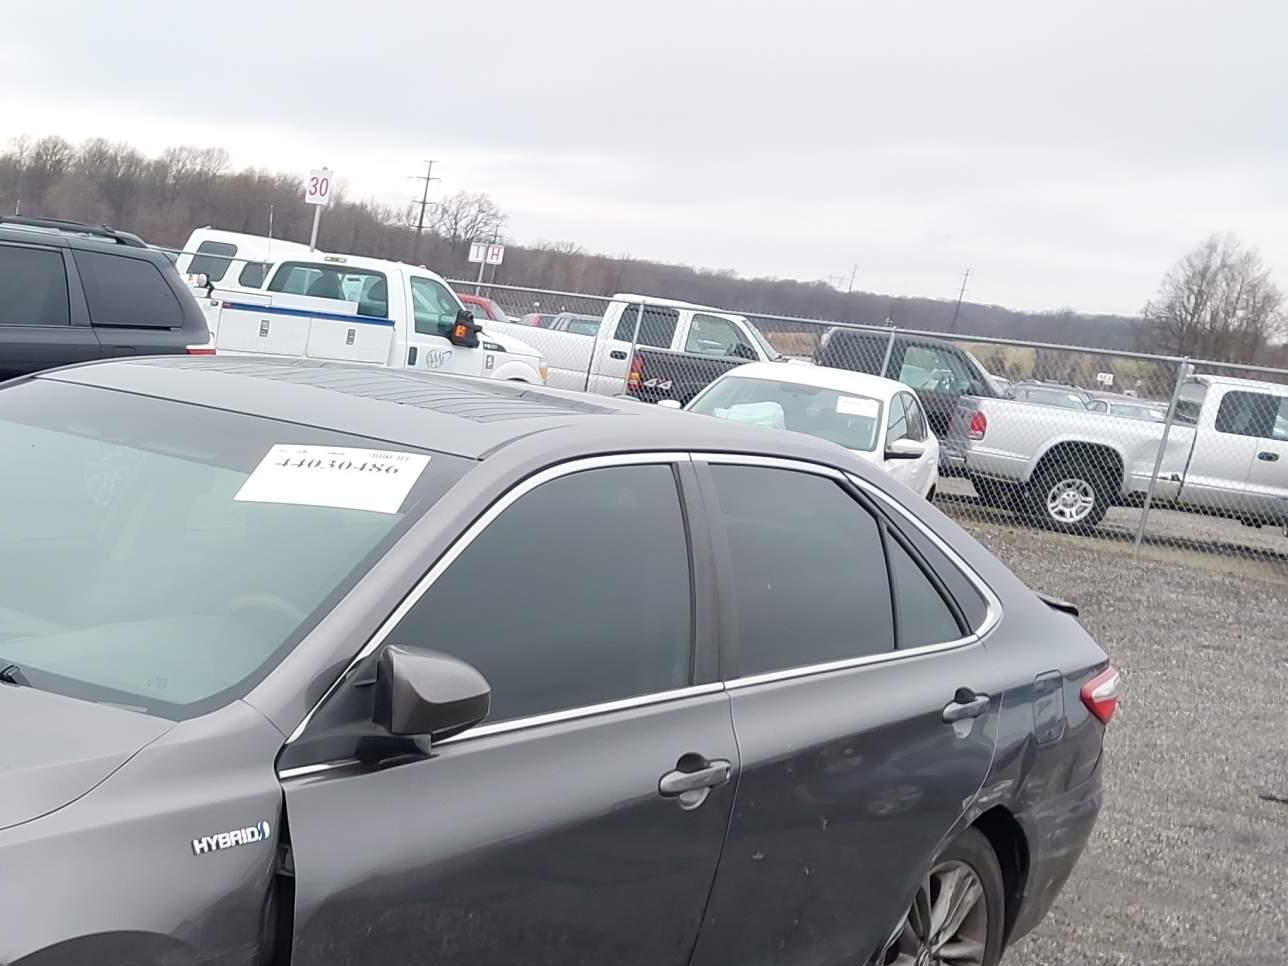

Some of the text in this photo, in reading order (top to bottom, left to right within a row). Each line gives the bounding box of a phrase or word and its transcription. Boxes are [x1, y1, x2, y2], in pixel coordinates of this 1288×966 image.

[308, 176, 329, 197] 30
[275, 457, 399, 474] 44030486
[192, 826, 259, 855] HYBRID
